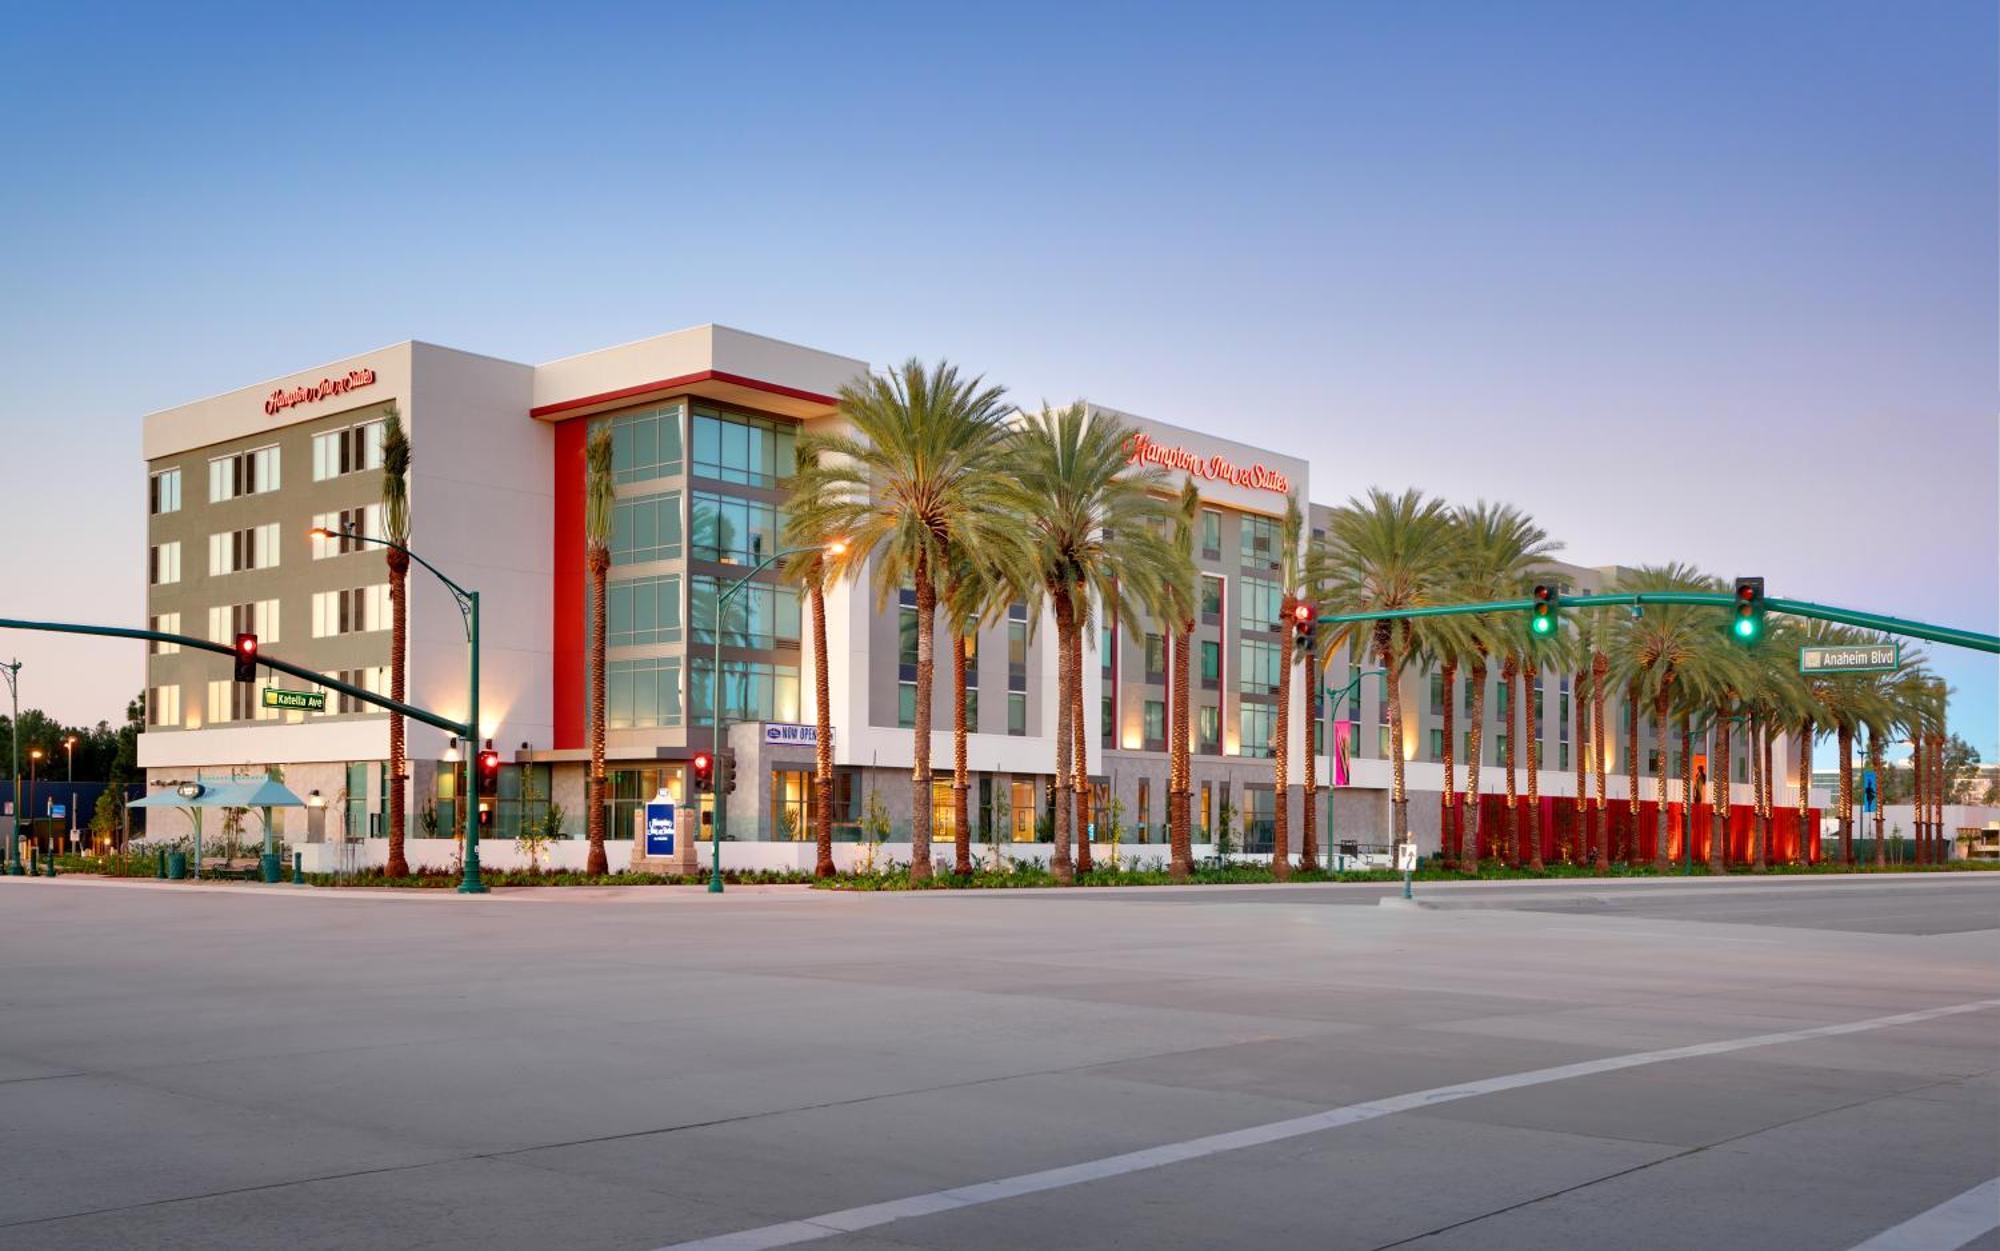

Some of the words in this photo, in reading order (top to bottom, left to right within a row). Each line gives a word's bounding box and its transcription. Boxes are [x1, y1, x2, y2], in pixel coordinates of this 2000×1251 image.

[1122, 433, 1203, 477] Hampton
[1203, 455, 1241, 486] Inn
[1250, 464, 1289, 493] Suites
[1824, 651, 1868, 666] Anaheim
[1871, 649, 1893, 664] Blvd
[279, 694, 306, 706] Katella
[308, 697, 322, 708] Ave
[782, 726, 798, 740] NOW
